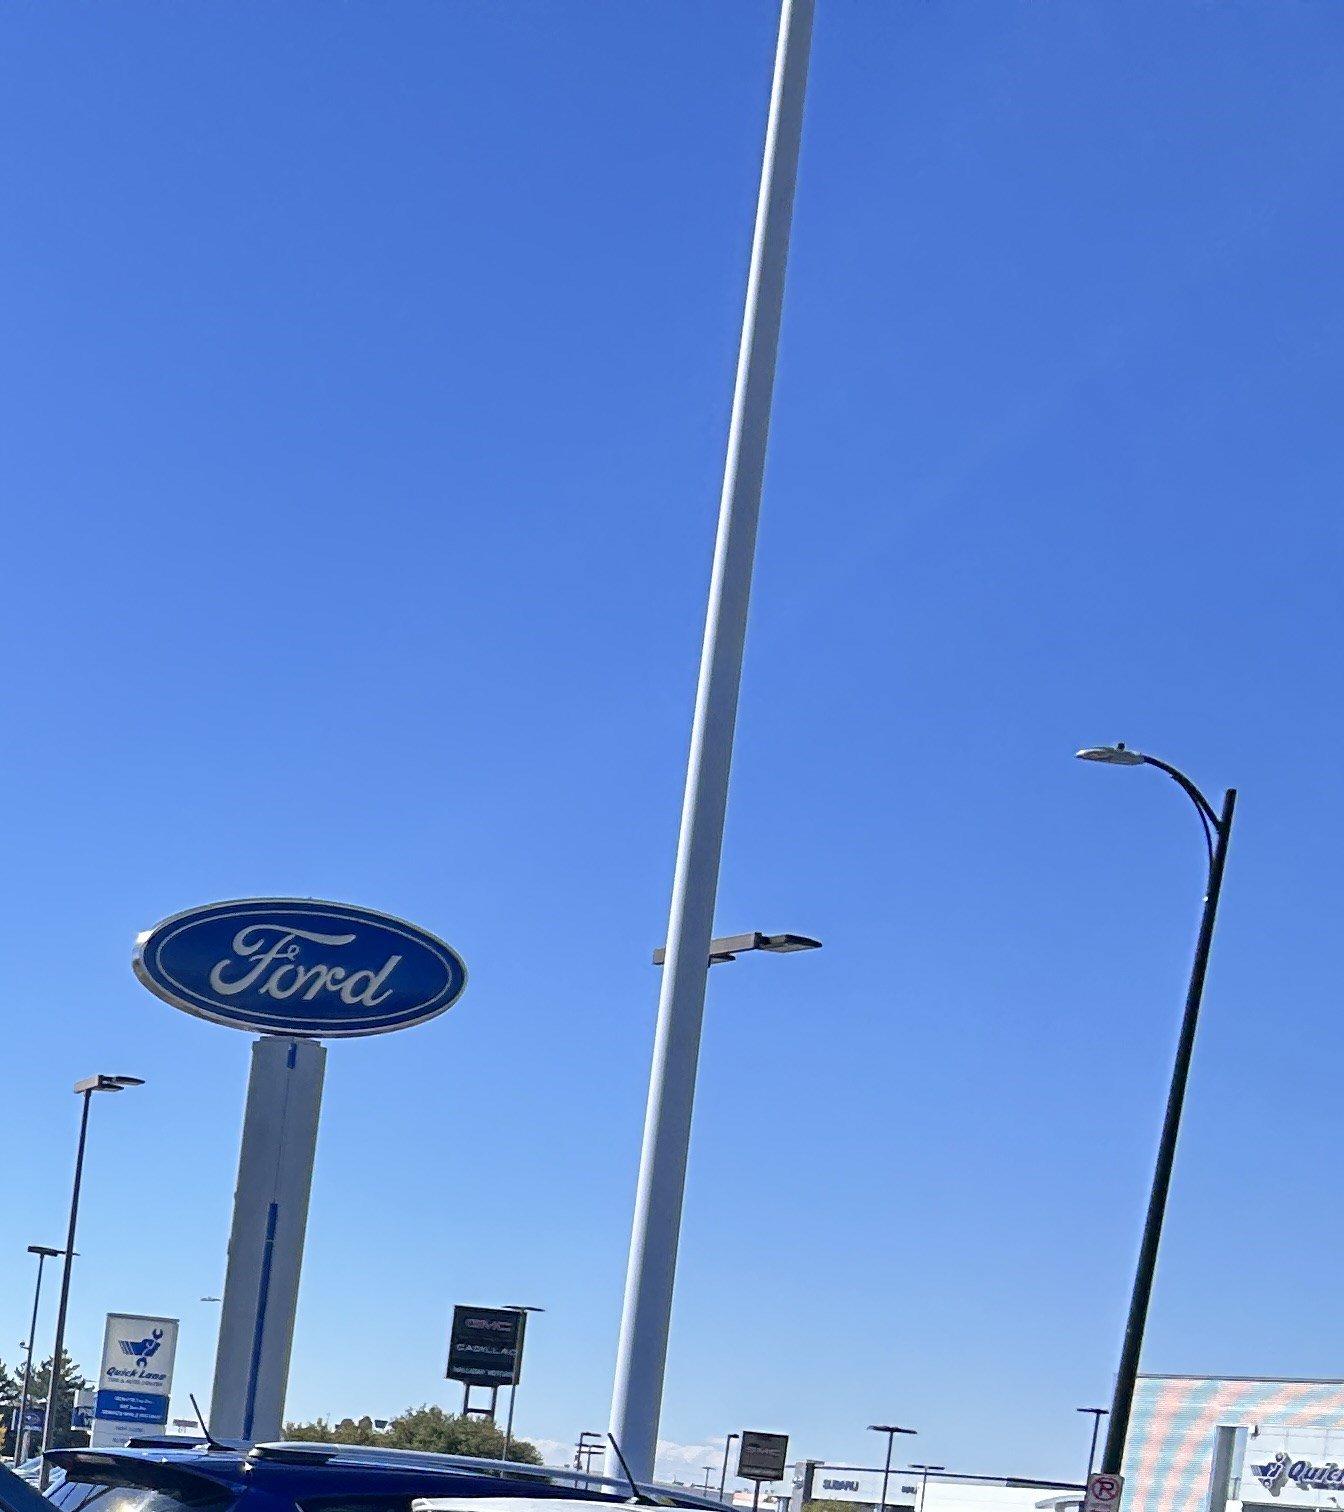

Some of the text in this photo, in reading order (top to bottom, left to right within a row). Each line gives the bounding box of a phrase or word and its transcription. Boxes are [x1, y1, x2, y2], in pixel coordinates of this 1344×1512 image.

[210, 924, 403, 1007] Ford
[465, 1318, 512, 1332] GMC
[456, 1344, 517, 1356] CADILLAC
[106, 1366, 167, 1381] Quick Lane
[822, 1479, 860, 1492] SUBARU
